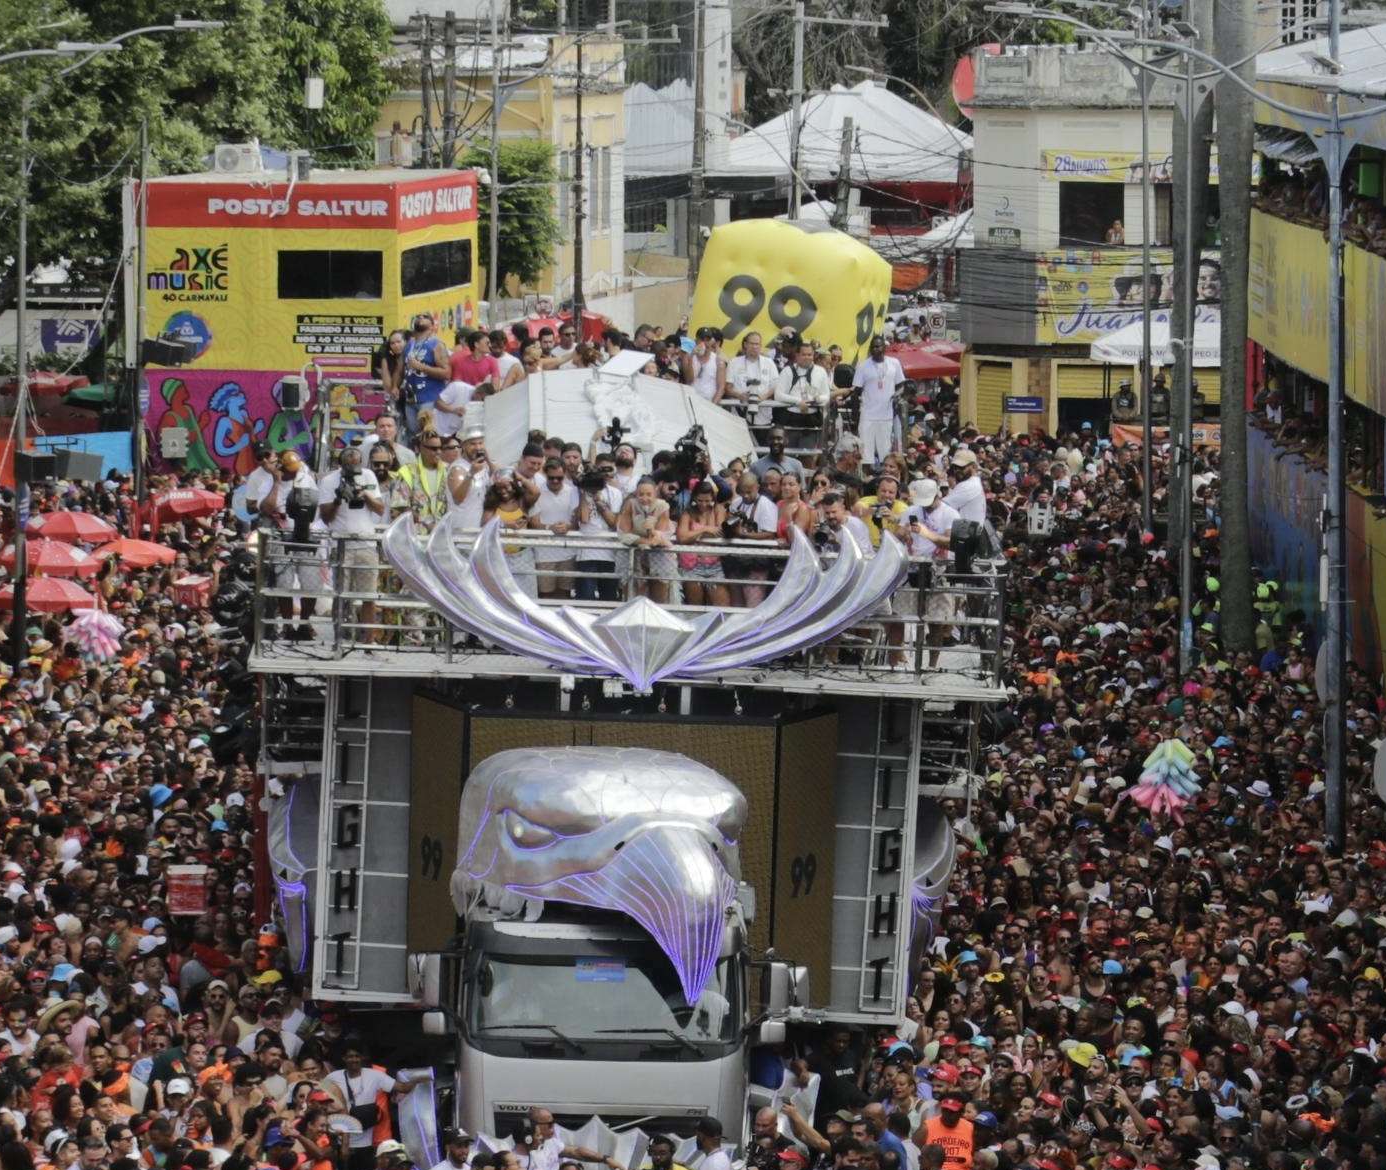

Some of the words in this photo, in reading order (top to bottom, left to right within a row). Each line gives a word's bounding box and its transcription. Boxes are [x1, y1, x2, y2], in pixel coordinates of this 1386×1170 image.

[207, 198, 289, 218] POSTO
[297, 200, 389, 217] SALTUR
[400, 190, 434, 219] POSTO
[435, 185, 473, 212] SALTUR
[718, 274, 818, 348] 99
[421, 834, 444, 882] 99
[790, 852, 817, 898] 99
